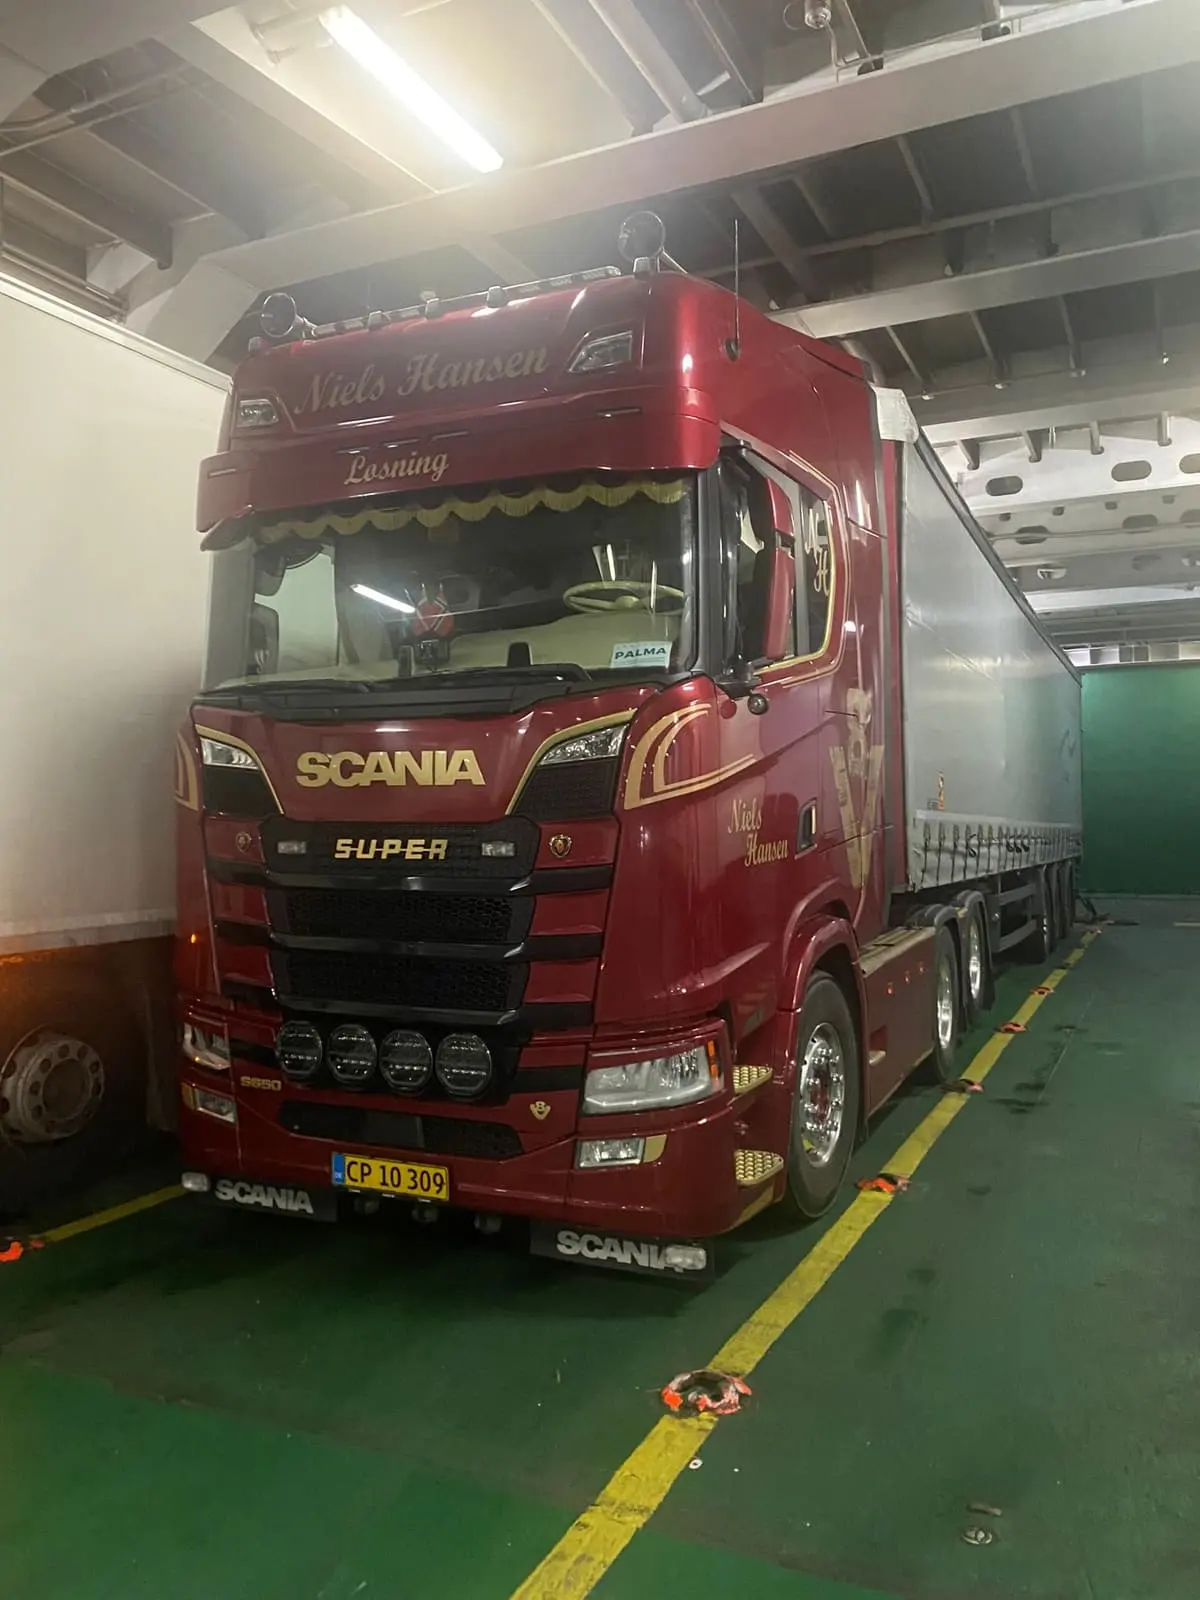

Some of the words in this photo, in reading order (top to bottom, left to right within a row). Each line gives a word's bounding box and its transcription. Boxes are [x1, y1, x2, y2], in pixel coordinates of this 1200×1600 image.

[294, 364, 386, 414] Niels
[396, 347, 549, 396] Hansen
[615, 647, 667, 659] PALMA
[295, 750, 486, 787] SCANIA
[728, 798, 762, 834] Niels
[334, 839, 448, 860] SUPER
[745, 833, 788, 867] Hansen
[346, 1161, 372, 1183] CP
[379, 1165, 402, 1188] 10
[407, 1168, 446, 1195] 309
[214, 1179, 314, 1214] SCANIA
